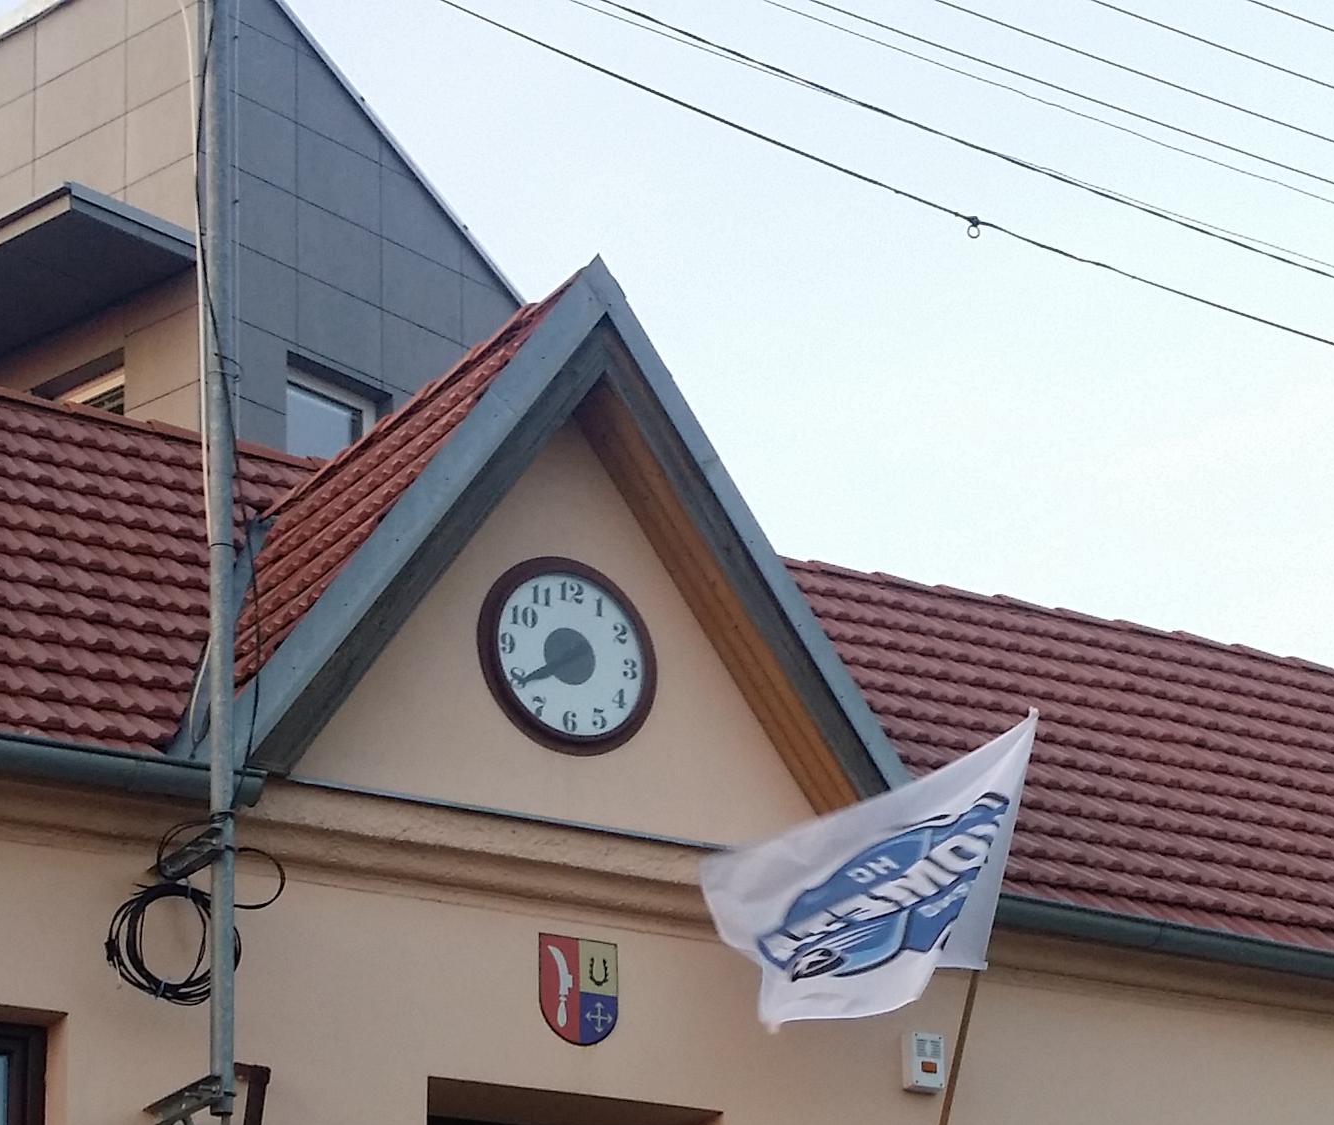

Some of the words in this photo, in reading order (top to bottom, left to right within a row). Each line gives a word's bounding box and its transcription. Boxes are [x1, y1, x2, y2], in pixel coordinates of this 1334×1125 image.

[532, 584, 551, 607] 11
[559, 581, 584, 604] 12
[510, 605, 538, 628] 10
[596, 596, 604, 617] 1
[500, 632, 515, 654] 9
[613, 622, 628, 645] 2
[510, 667, 526, 689] 8
[623, 658, 638, 680] 3
[532, 695, 547, 718] 7
[612, 688, 627, 709] 4
[562, 711, 577, 732] 6
[592, 707, 607, 729] 5
